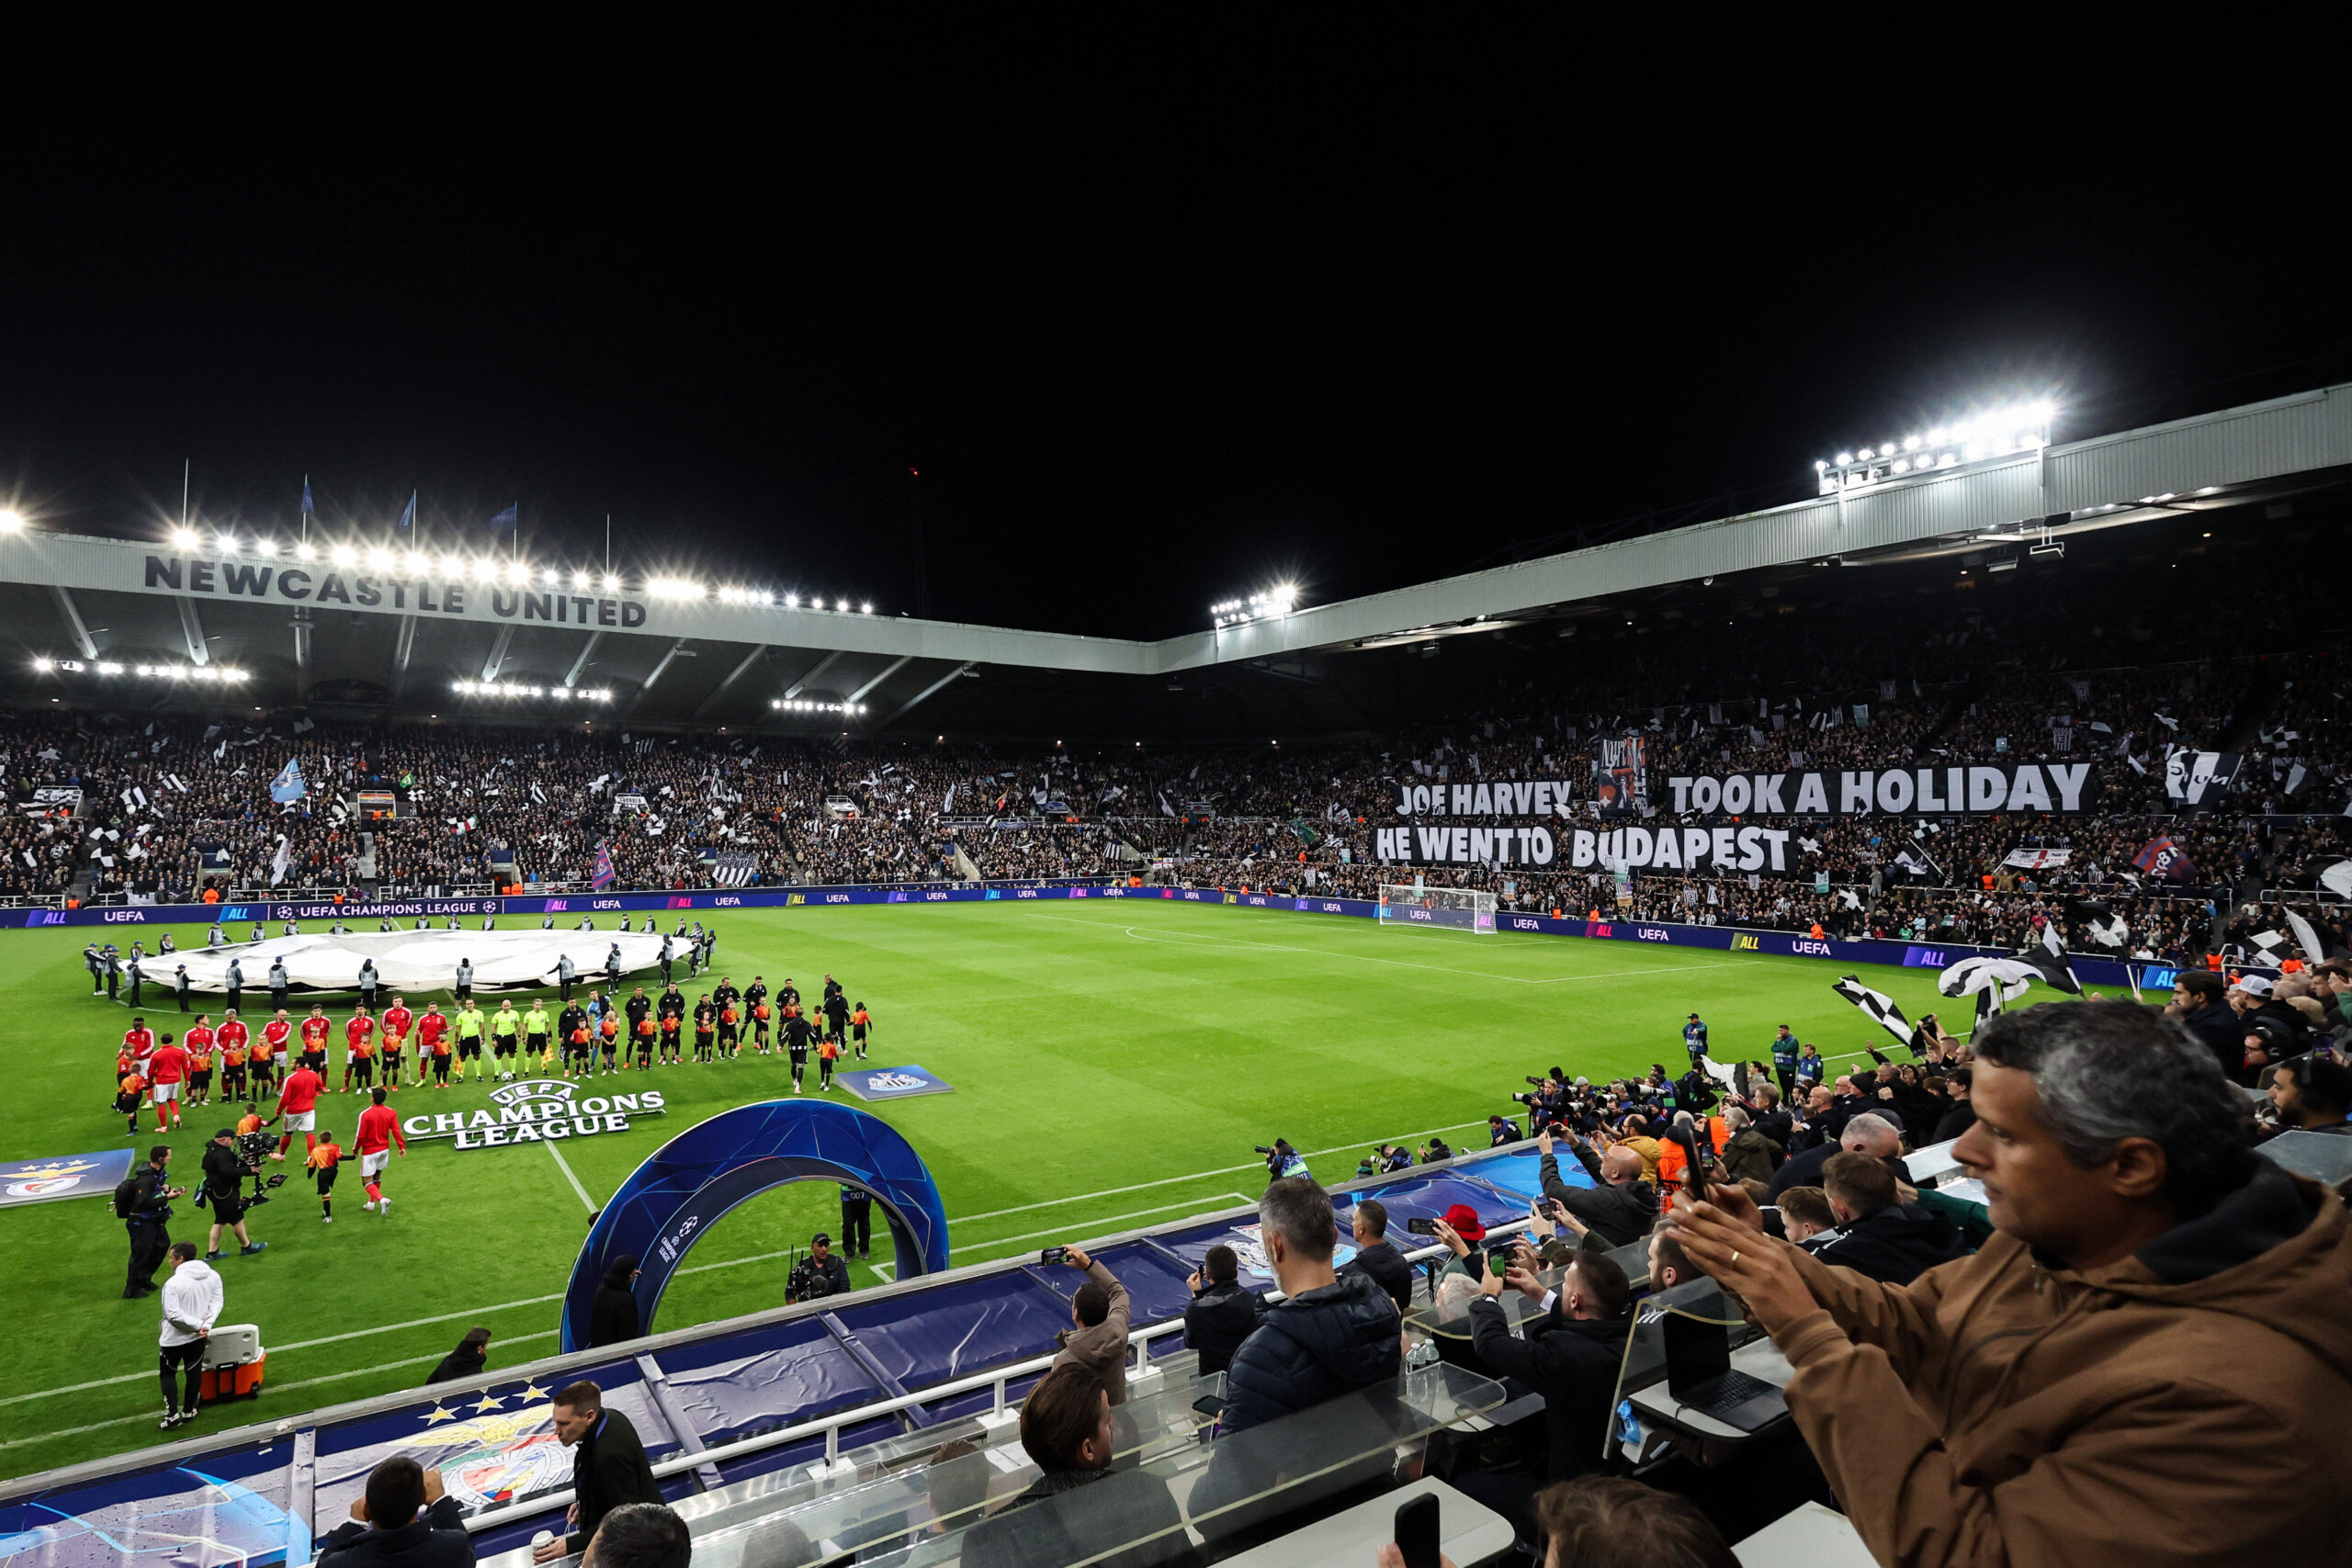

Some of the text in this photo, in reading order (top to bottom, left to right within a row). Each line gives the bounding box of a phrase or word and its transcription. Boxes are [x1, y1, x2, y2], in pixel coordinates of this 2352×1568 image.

[144, 555, 647, 628] NEWCASTLE UNITED
[1668, 773, 1787, 815] TOOK
[1794, 773, 1829, 813] A
[1840, 762, 2092, 814] HOLIDAY
[1396, 780, 1573, 817] JOE HARVEY
[1377, 826, 1555, 865] HE WENT TO
[1572, 826, 1789, 872] BUDAPEST
[896, 892, 908, 902] ALL
[926, 892, 948, 900] UEFA
[989, 889, 1001, 899] ALL
[1017, 889, 1037, 898] UEFA
[1076, 887, 1088, 897] ALL
[1102, 888, 1124, 897] UEFA
[1164, 890, 1173, 898] ALL
[1184, 891, 1199, 900] UEFA
[593, 899, 621, 909] UEFA
[678, 897, 692, 908] ALL
[715, 897, 741, 907] UEFA
[792, 894, 806, 905] ALL
[826, 894, 850, 903] UEFA
[1227, 895, 1238, 904] ALL
[1250, 897, 1266, 906] UEFA
[1298, 899, 1309, 910] ALL
[300, 901, 477, 917] UEFA CHAMPIONS LEAGUE
[552, 899, 568, 911] ALL
[1322, 902, 1341, 912] UEFA
[43, 912, 66, 924] ALL
[104, 910, 145, 922] UEFA
[227, 908, 248, 919] ALL
[1382, 906, 1393, 918] ALL
[1409, 909, 1431, 920] UEFA
[1478, 915, 1492, 927] ALL
[1513, 919, 1540, 931] UEFA
[1596, 925, 1612, 937] ALL
[1637, 929, 1669, 942] UEFA
[1739, 937, 1759, 950] ALL
[1792, 940, 1831, 955] UEFA
[1920, 951, 1945, 966] ALL
[2155, 970, 2178, 987] AL
[492, 1083, 573, 1104] UEFA
[402, 1090, 665, 1135] CHAMPIONS
[454, 1111, 630, 1149] LEAGUE
[850, 1191, 865, 1200] 007
[662, 1236, 677, 1259] CHAMPIONS
[659, 1246, 671, 1263] LEAGUE
